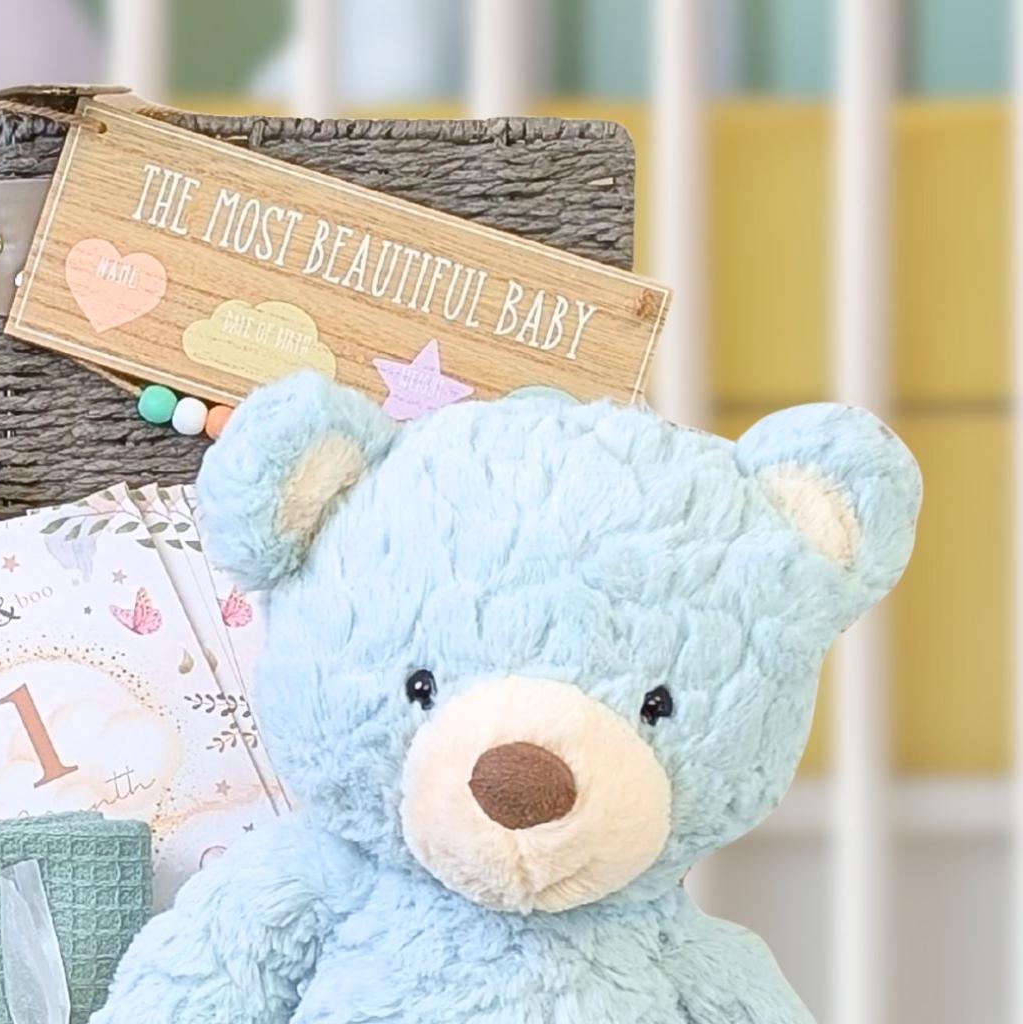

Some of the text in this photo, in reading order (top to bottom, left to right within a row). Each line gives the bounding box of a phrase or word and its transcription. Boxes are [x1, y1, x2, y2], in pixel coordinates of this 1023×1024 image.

[131, 165, 597, 360] THE MOST BEAUTIFUL BABY
[14, 585, 54, 609] boo
